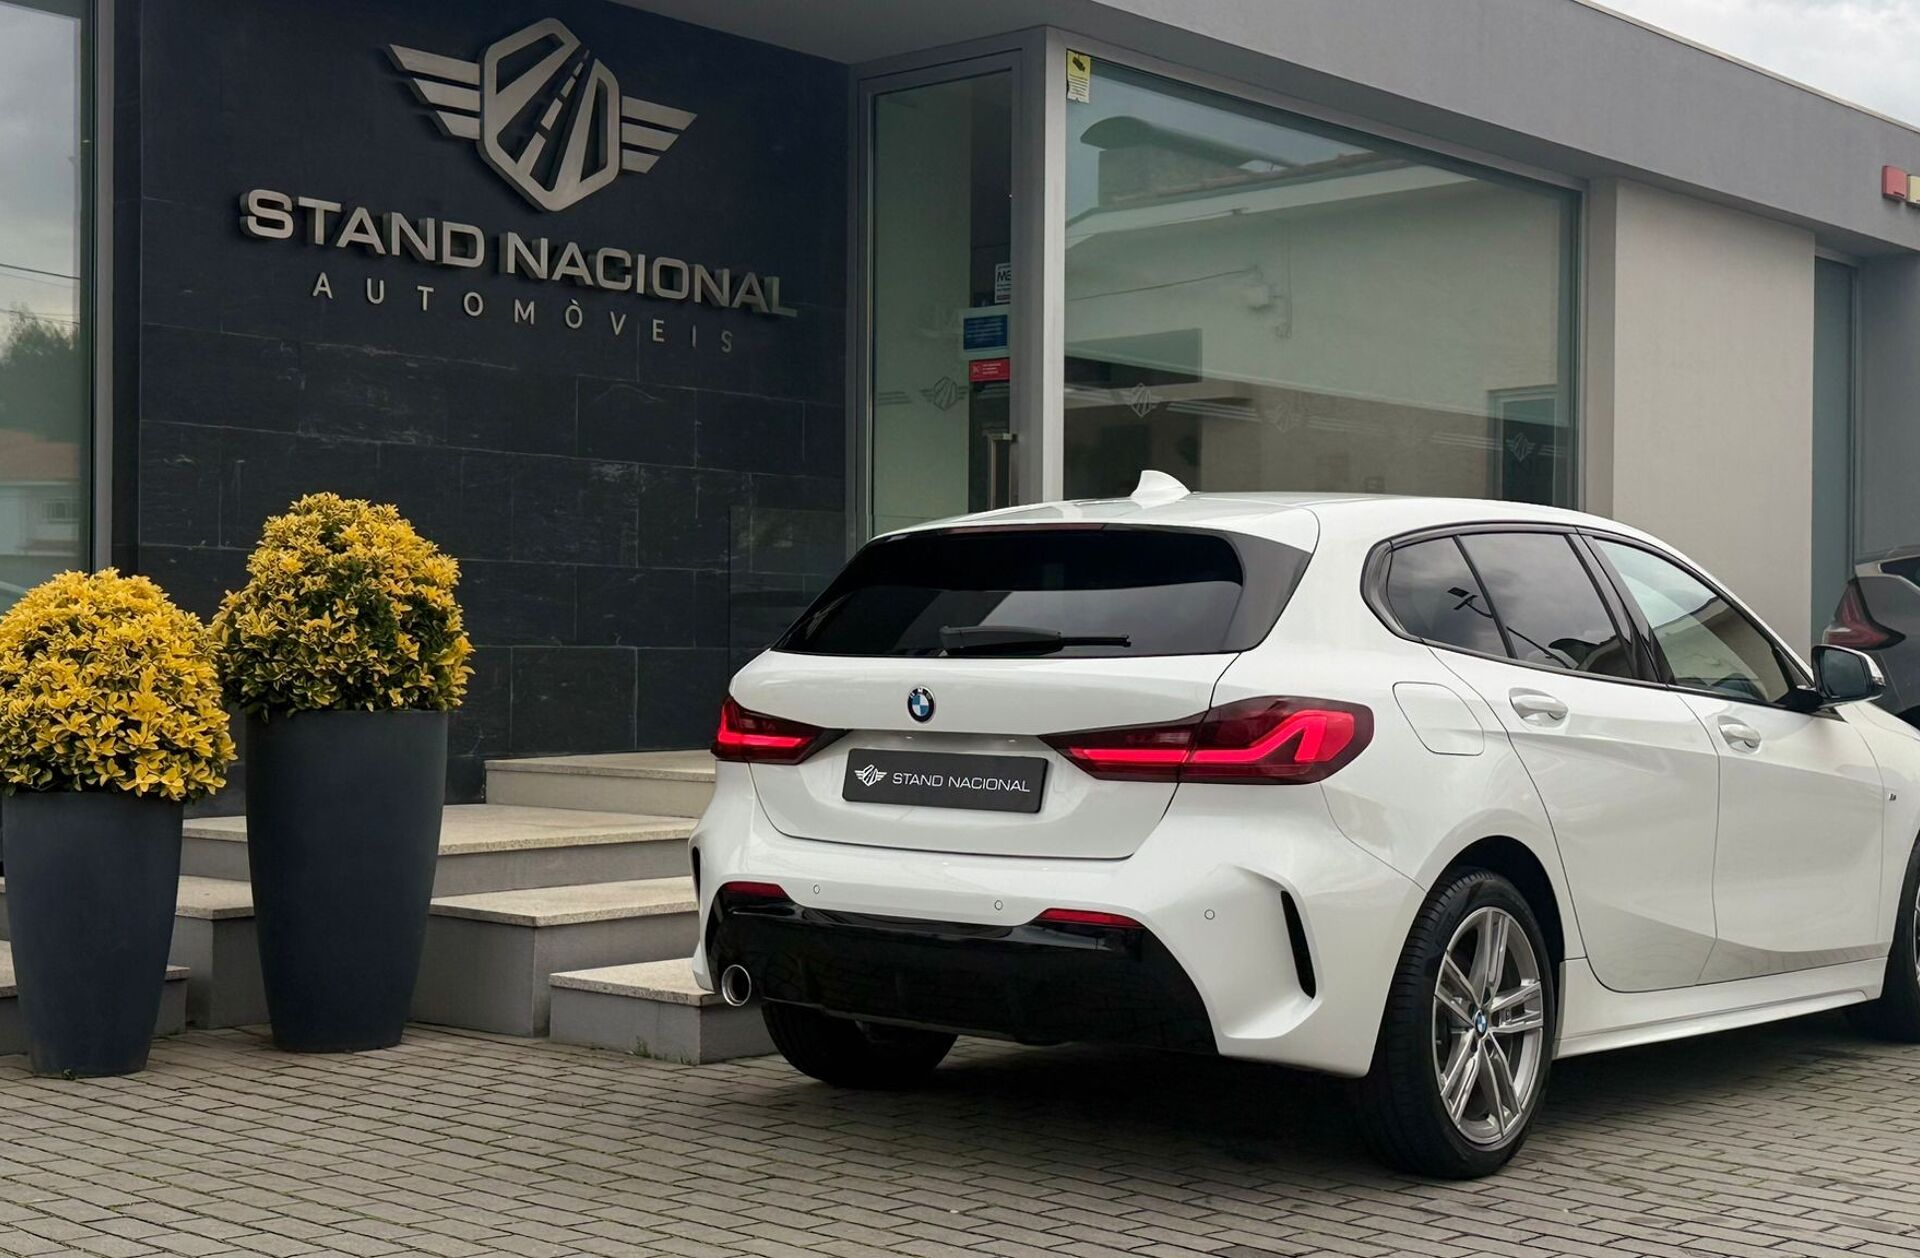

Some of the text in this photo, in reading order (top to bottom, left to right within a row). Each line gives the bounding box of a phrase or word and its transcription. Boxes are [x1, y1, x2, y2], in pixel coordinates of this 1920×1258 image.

[241, 188, 797, 318] STAND NACIONAL
[892, 772, 1031, 793] STAND NACIONAL
